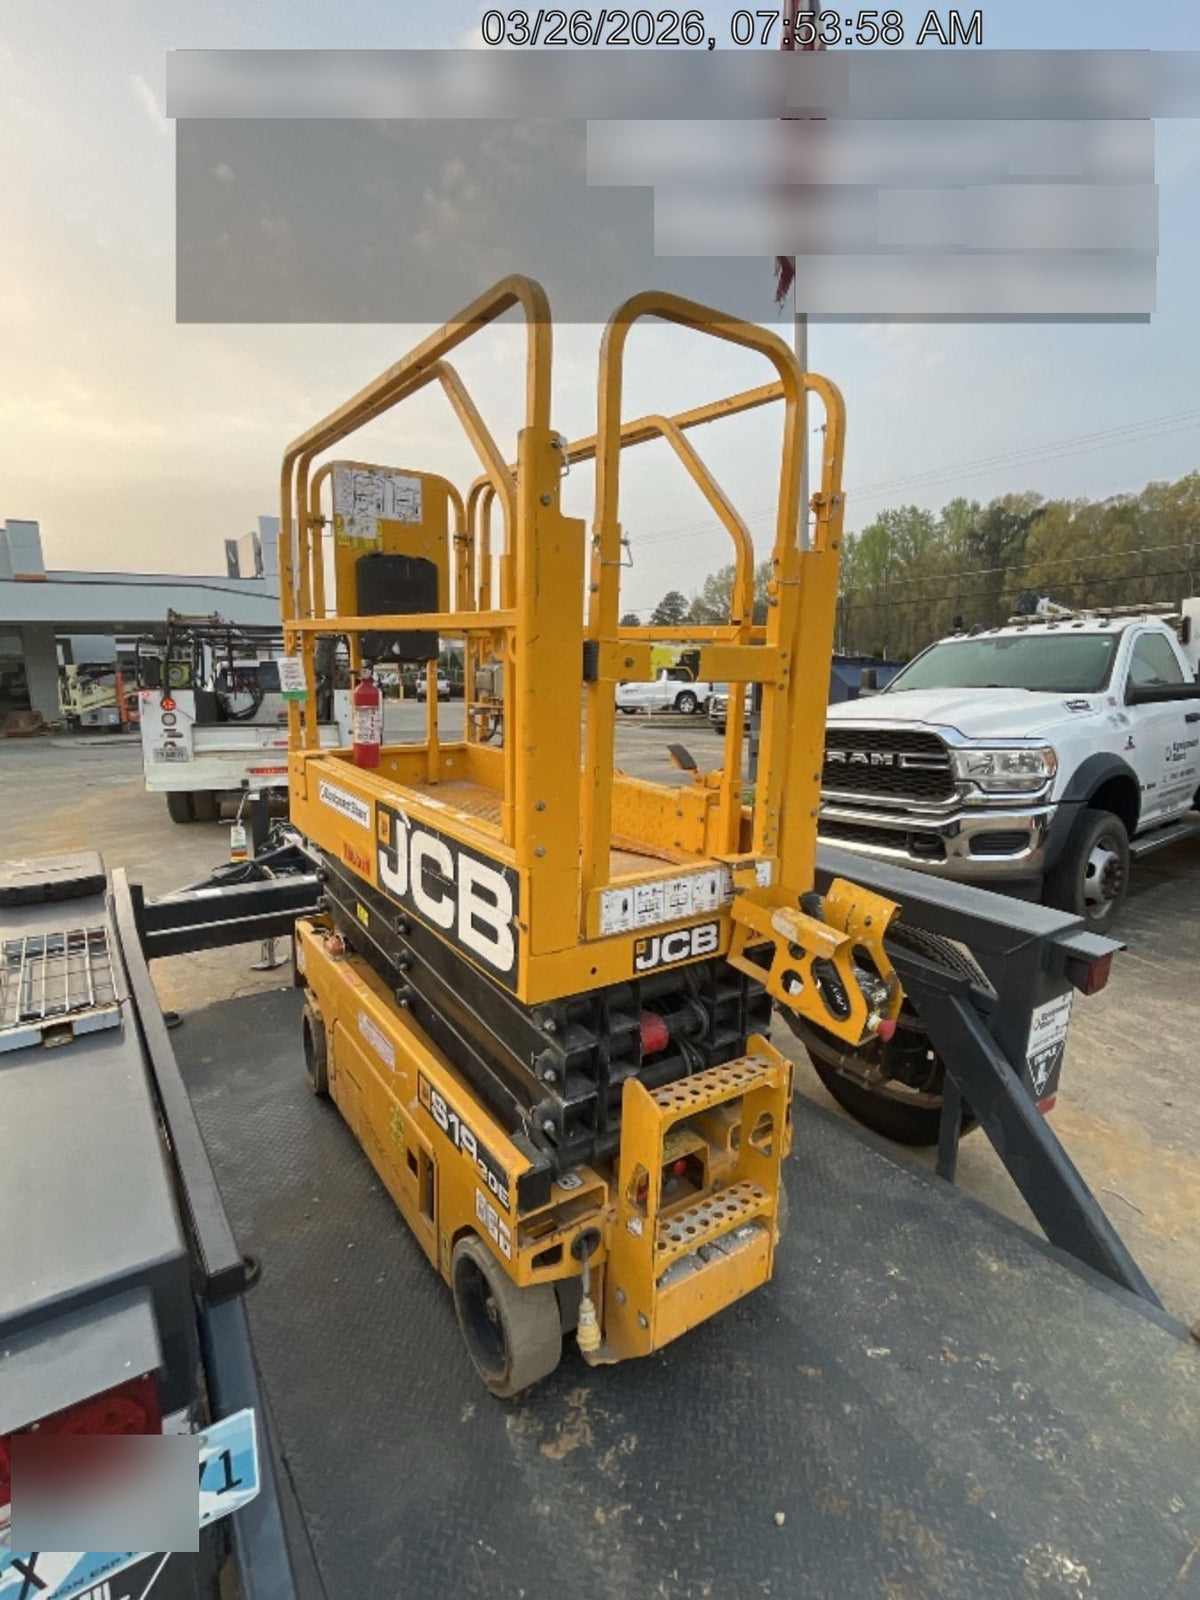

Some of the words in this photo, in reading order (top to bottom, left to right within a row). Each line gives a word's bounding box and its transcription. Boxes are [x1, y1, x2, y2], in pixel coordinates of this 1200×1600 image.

[826, 751, 893, 765] RAM
[379, 809, 515, 972] JCB
[635, 923, 718, 970] JCB
